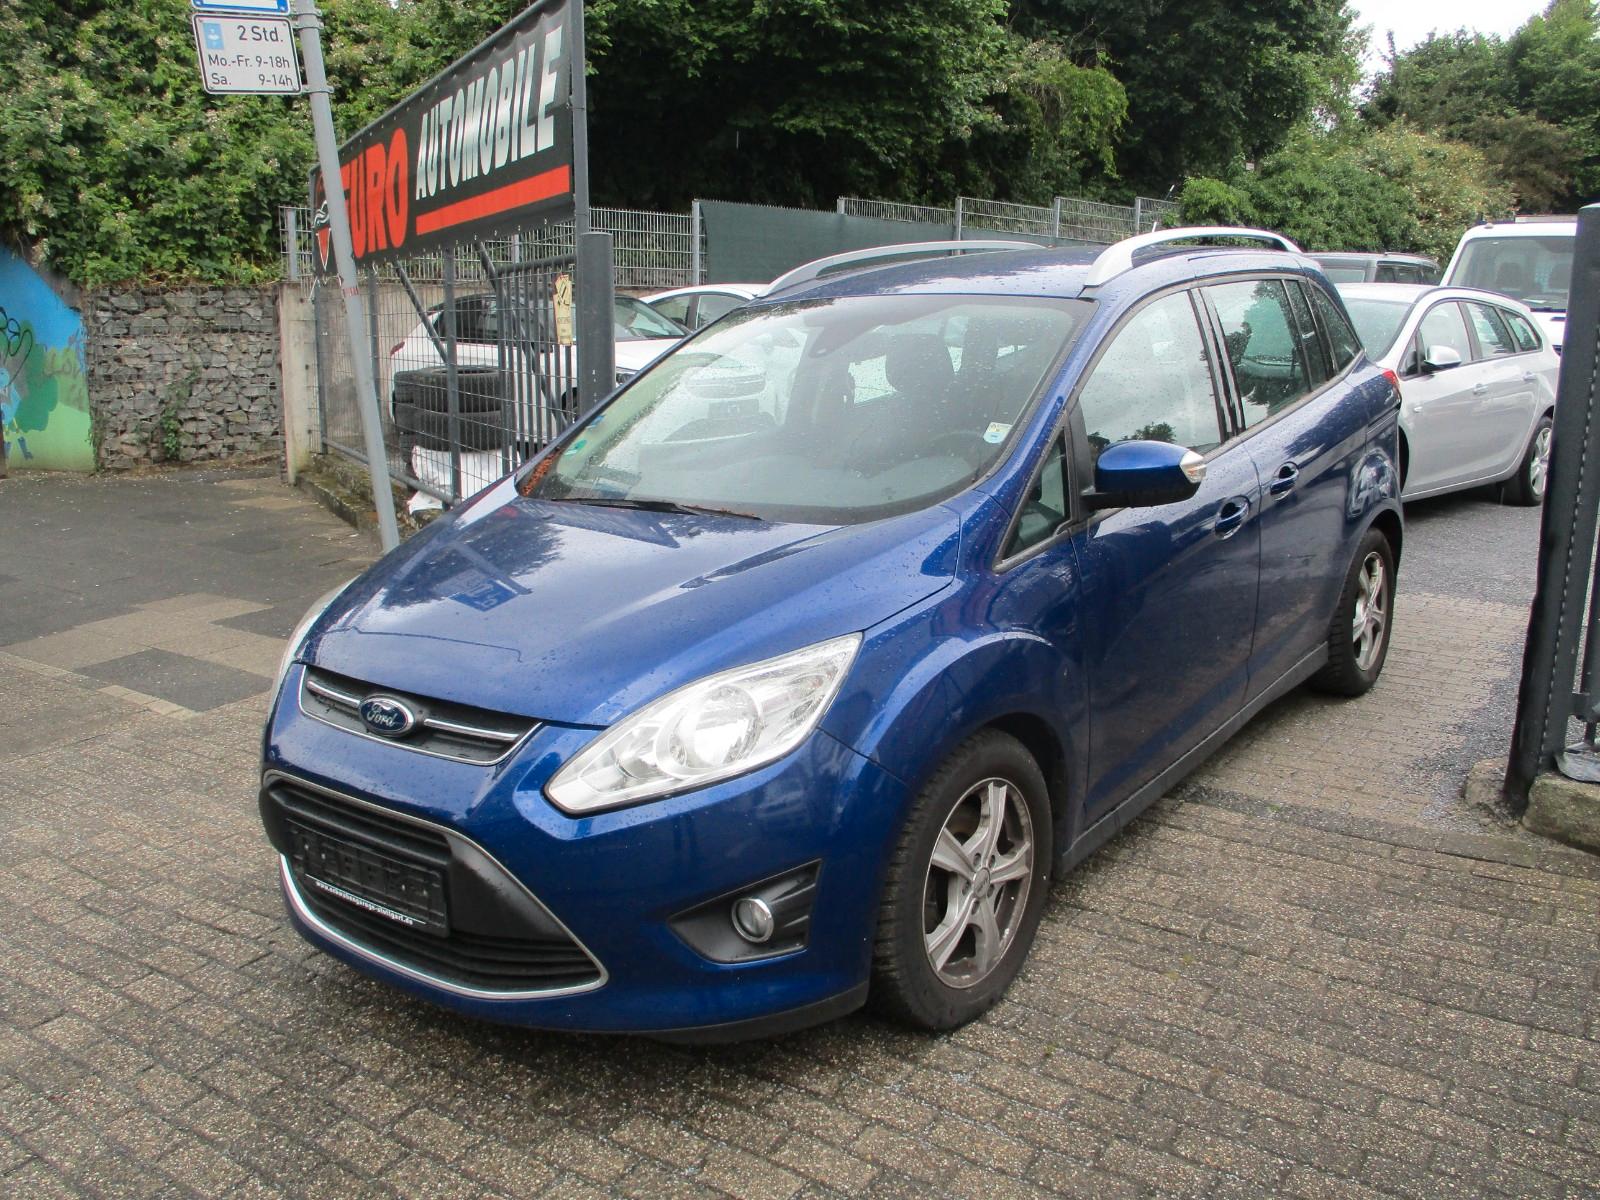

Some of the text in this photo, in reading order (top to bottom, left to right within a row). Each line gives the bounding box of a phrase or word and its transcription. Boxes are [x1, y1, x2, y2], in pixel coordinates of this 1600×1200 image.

[237, 25, 284, 43] 2 Std.
[208, 54, 290, 68] Mo.-Fr. 9-18h
[211, 73, 293, 87] Sa. 9-14h
[416, 25, 562, 200] AUTOMOBILE
[366, 702, 398, 727] Ford
